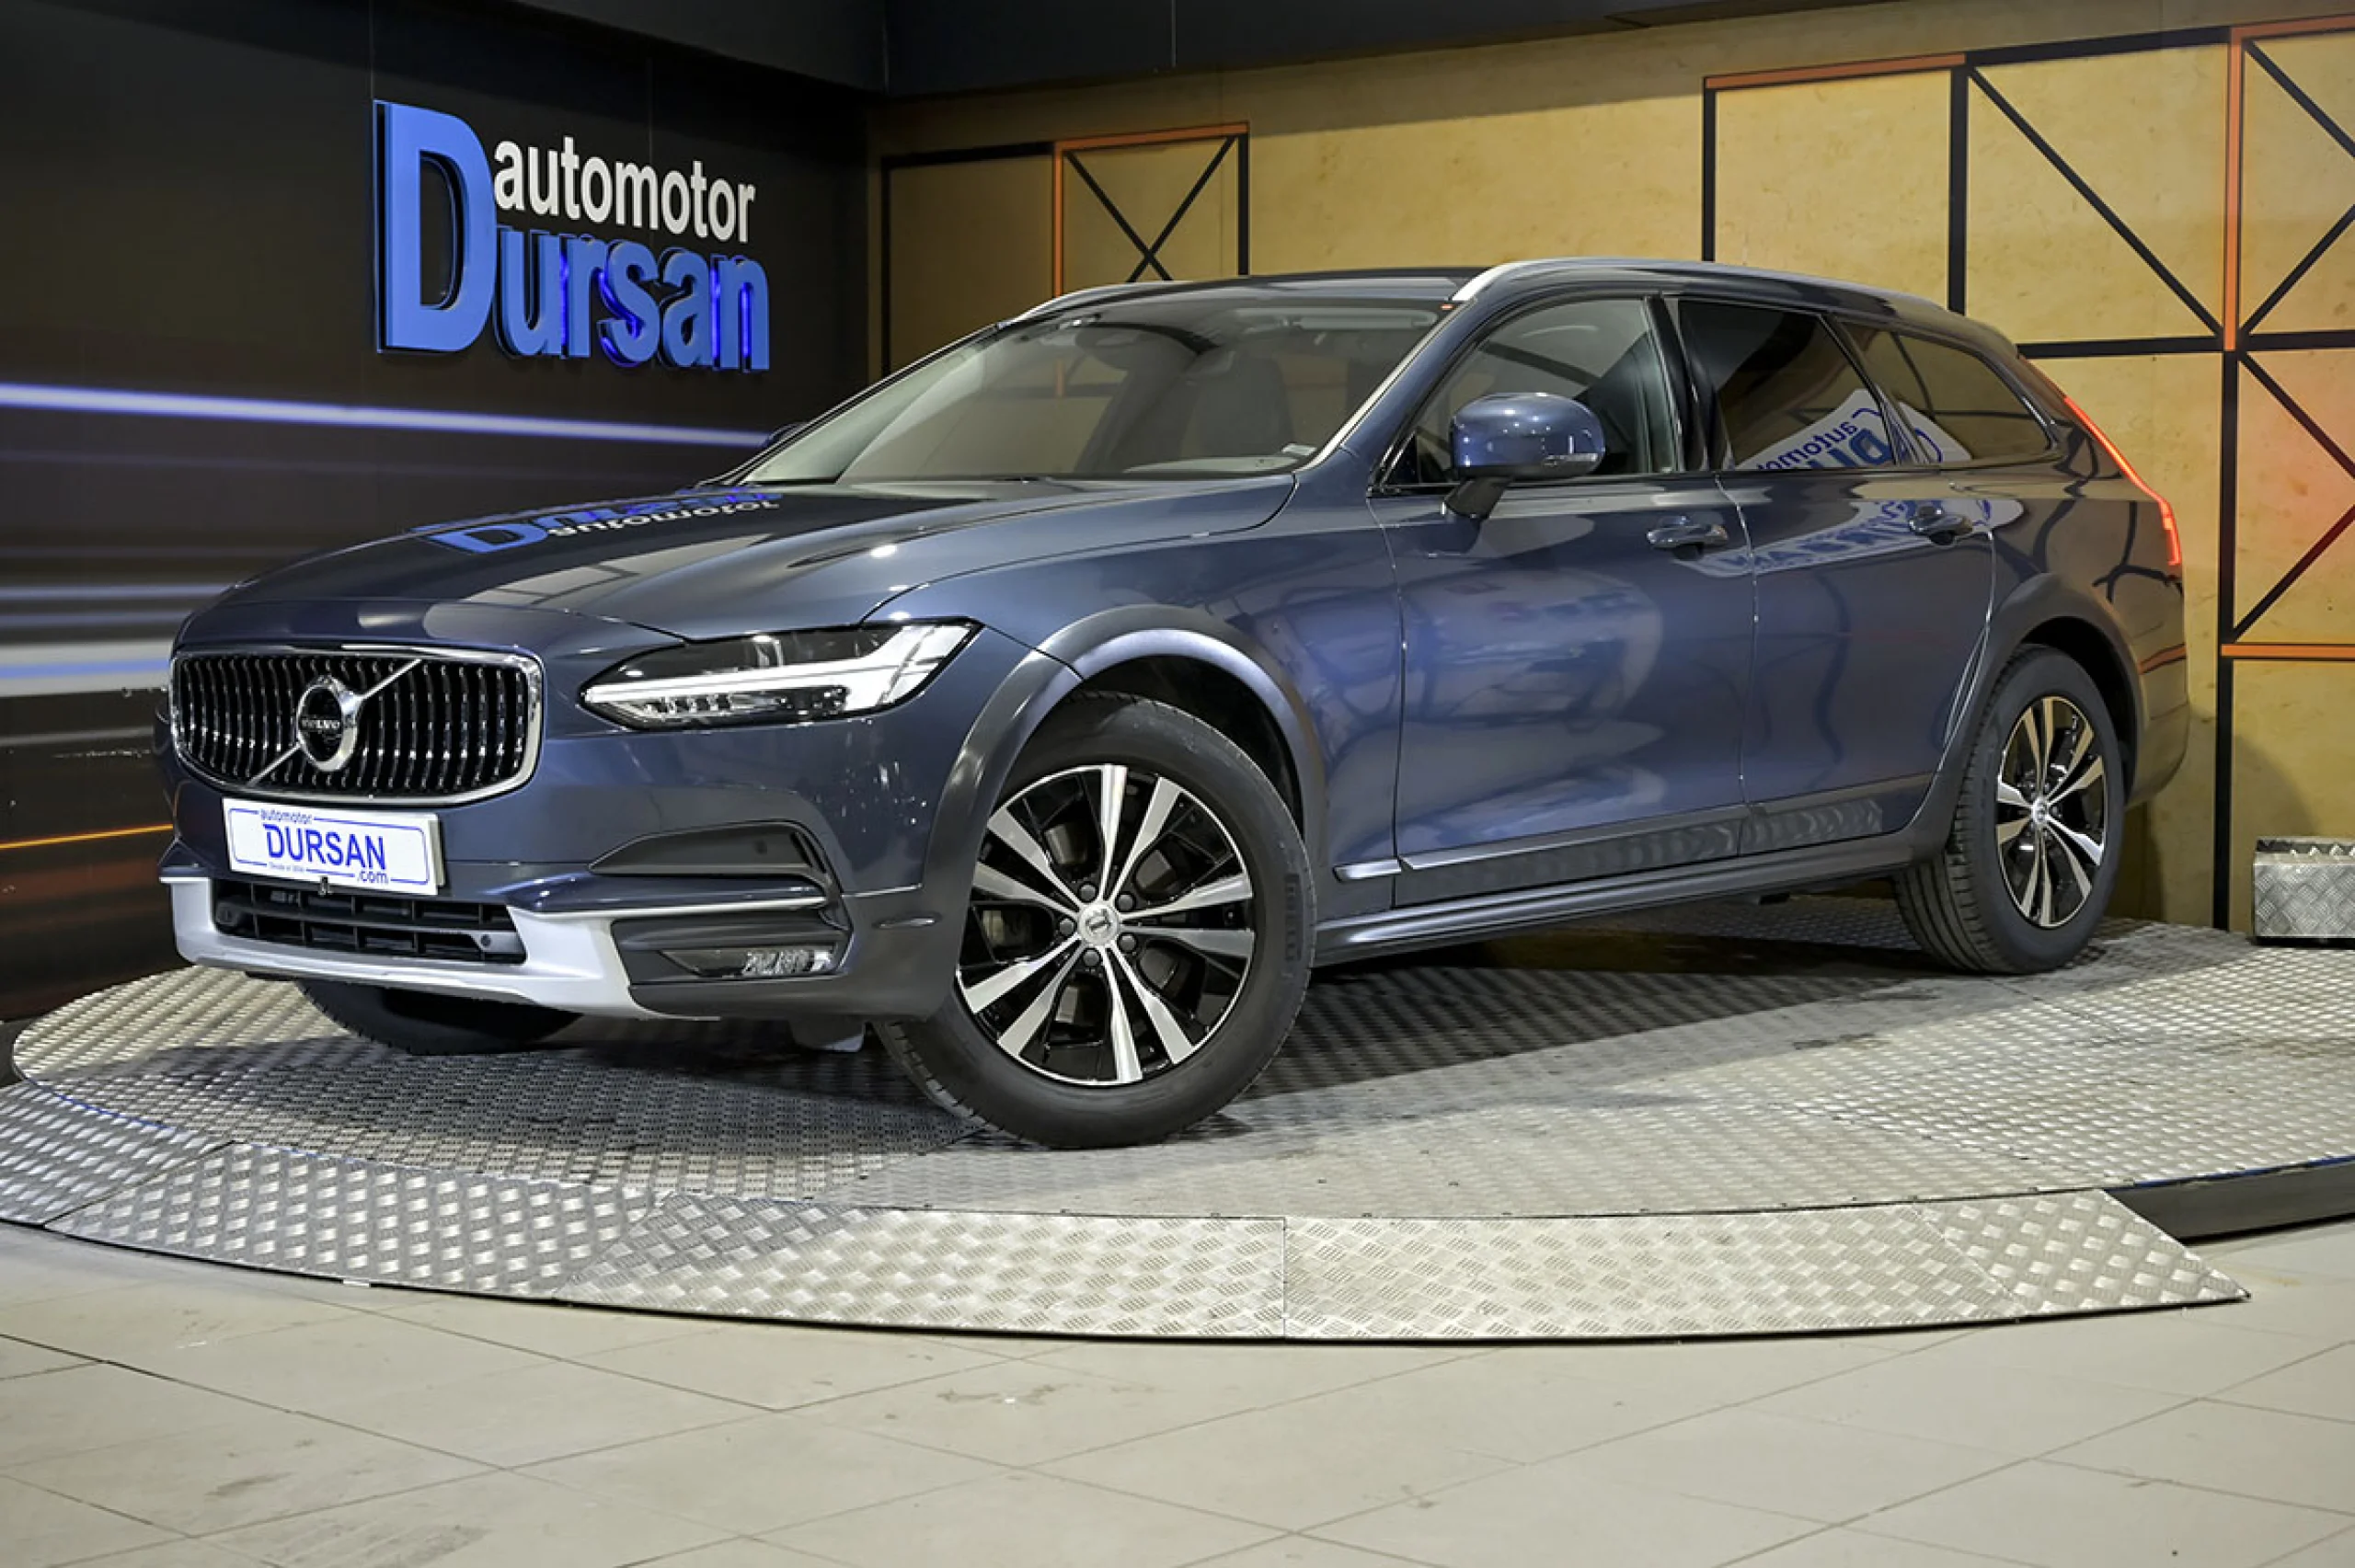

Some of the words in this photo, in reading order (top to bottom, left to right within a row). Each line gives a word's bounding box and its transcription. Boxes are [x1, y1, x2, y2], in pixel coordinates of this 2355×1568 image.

[494, 136, 756, 243] automotor
[373, 99, 770, 372] Dursan
[260, 808, 313, 825] automotor
[262, 822, 387, 871] DURSAN
[357, 870, 389, 885] .com
